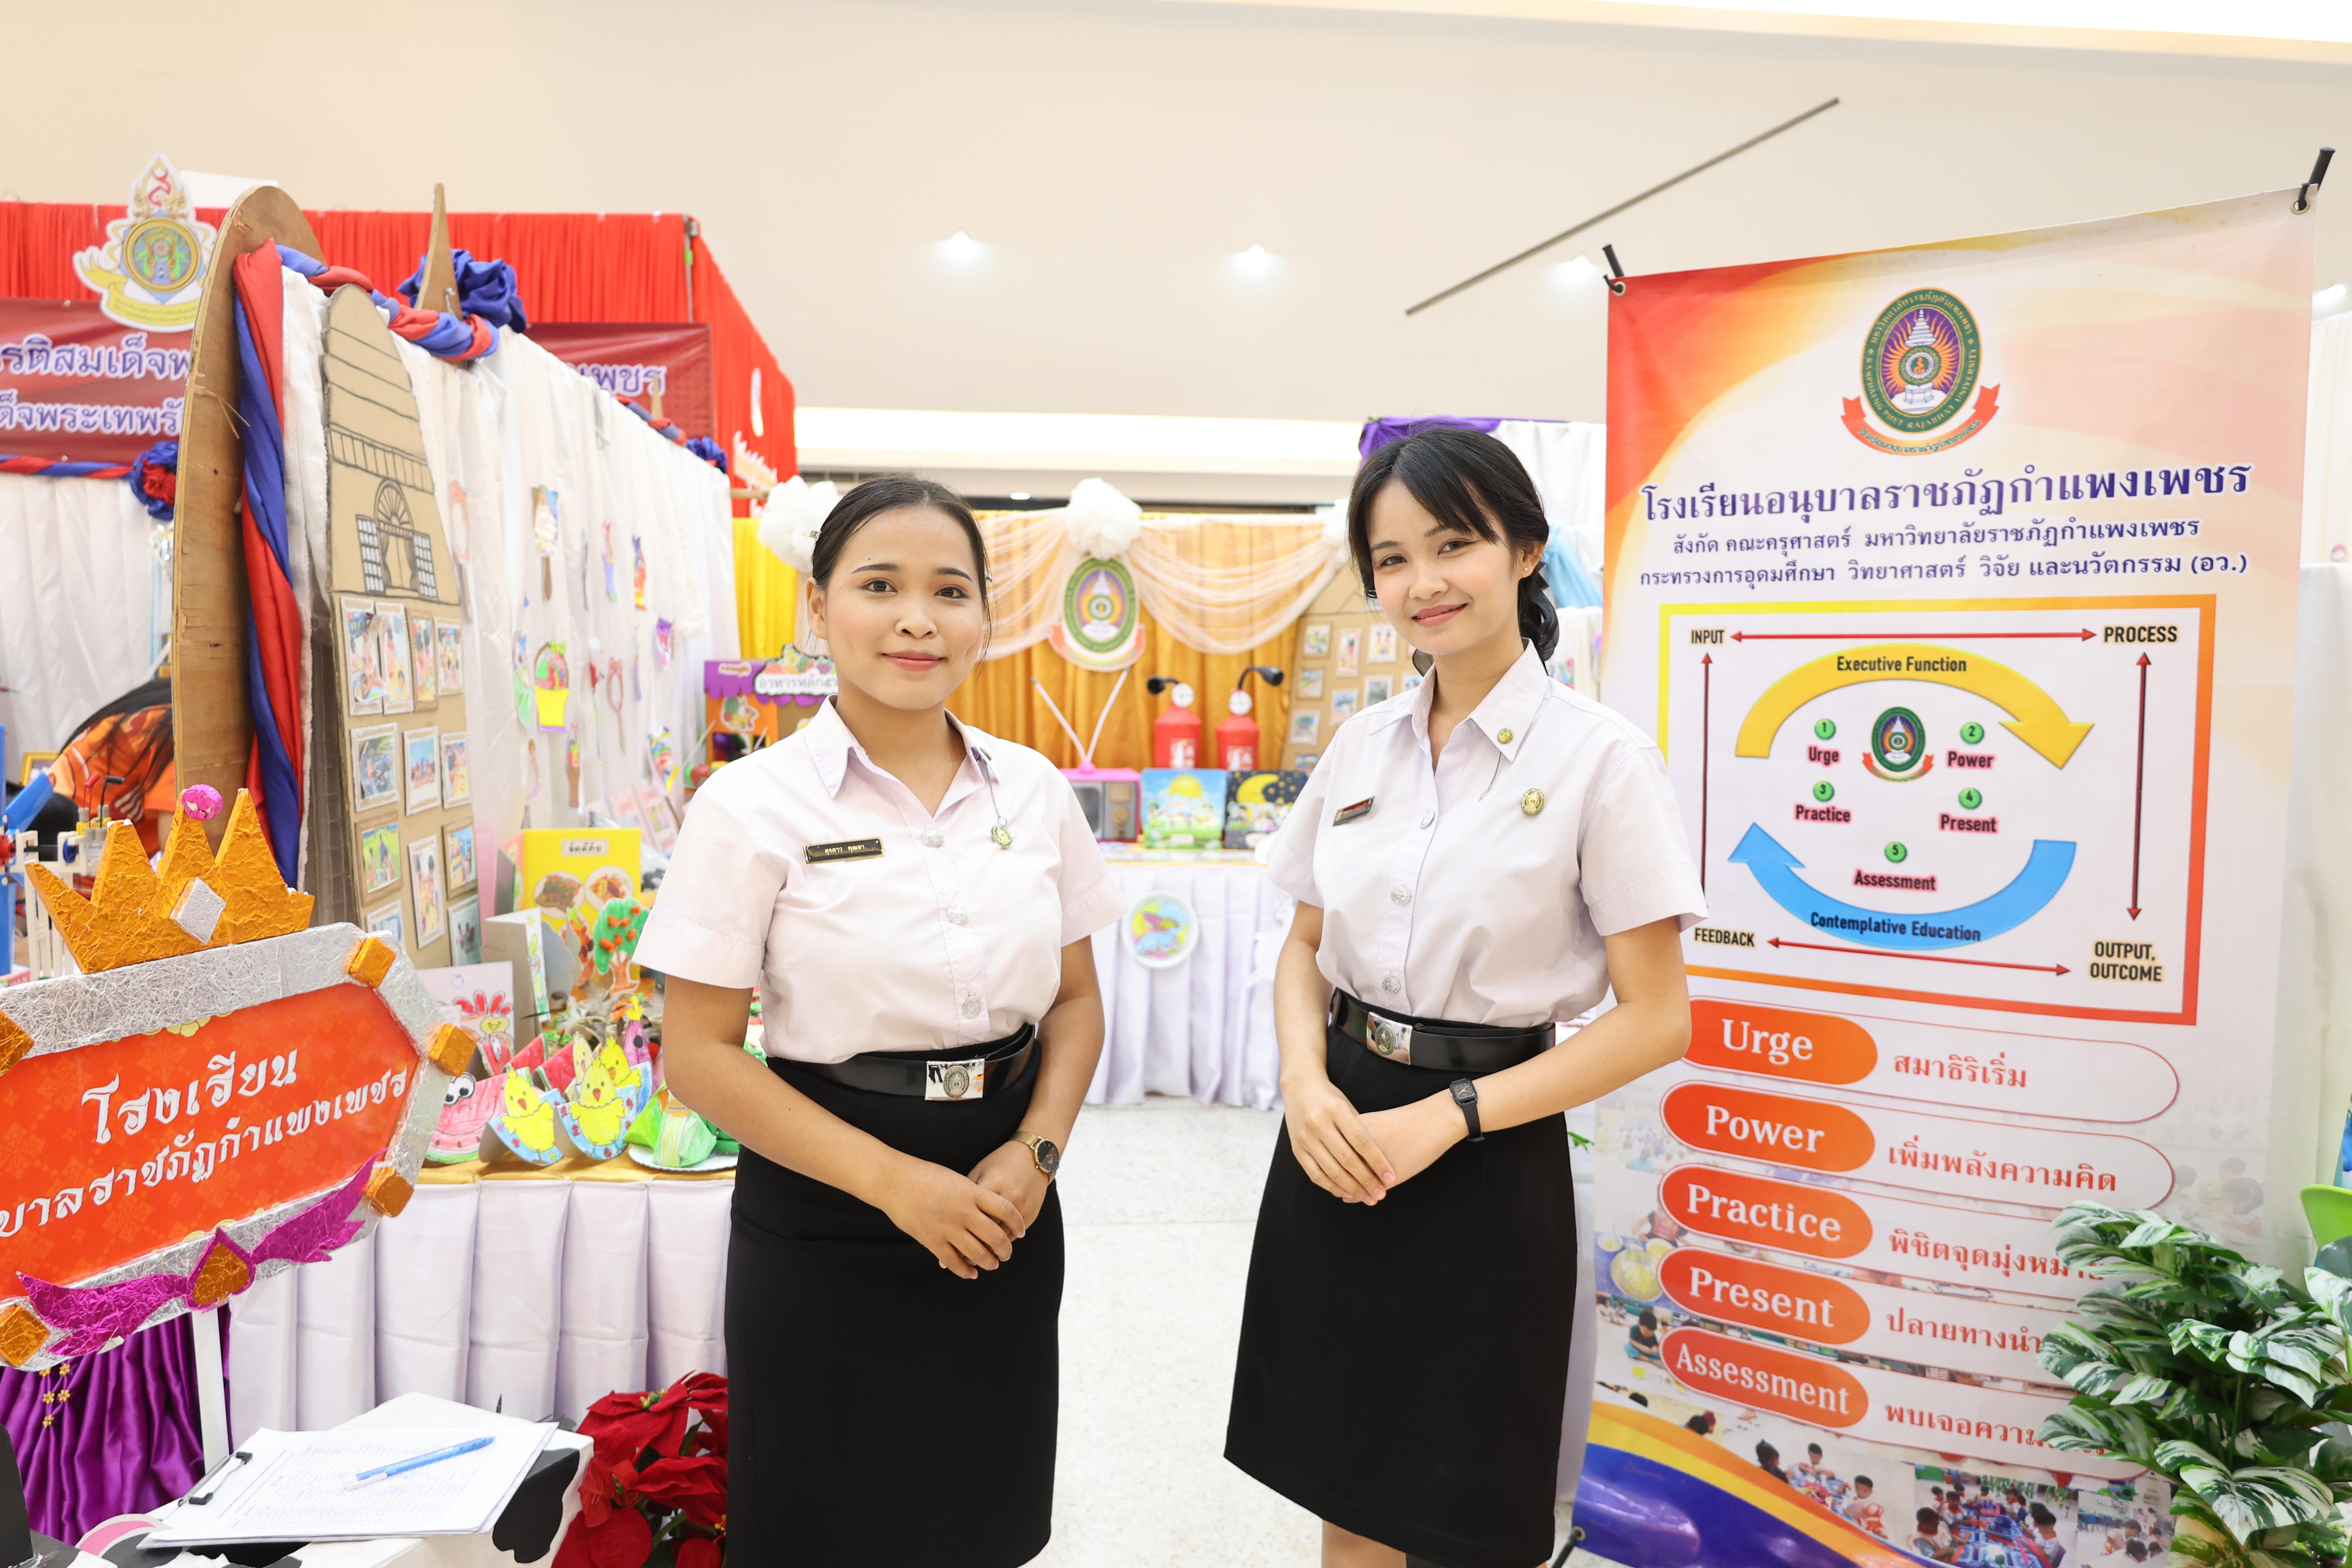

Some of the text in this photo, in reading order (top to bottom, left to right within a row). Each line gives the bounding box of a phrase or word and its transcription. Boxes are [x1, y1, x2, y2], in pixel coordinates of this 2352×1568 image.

[1882, 410, 1904, 426] PHET
[1906, 404, 1955, 429] RAJABHAT
[1641, 464, 2252, 523] โรงเรียนอนุบาลราชภัฏกำแพงเพชร
[1673, 517, 2200, 557] สังกัด คณะครุศาสตร์ มหาวิทยาลัยราชภัฏกำแพงเพชร
[1641, 551, 2247, 590] กระทรวงการอุดมศึกษา วิทยาศาสตร์ วิจัย และนวัตกรรม (อว.)
[1691, 630, 1724, 644] INPUT
[2104, 625, 2178, 643] PROCESS
[1837, 656, 1967, 672] Executive Function
[1822, 723, 1827, 733] 1
[1968, 726, 1976, 737] 2
[1809, 747, 1839, 765] Urge
[1947, 751, 1993, 768] Power
[1820, 784, 1827, 795] 3
[1965, 791, 1973, 802] 4
[1795, 805, 1851, 823] Practice
[1940, 814, 1997, 833] Present
[1892, 844, 1899, 856] 5
[1855, 871, 1936, 891] Assessment
[1694, 927, 1755, 947] FEEDBACK
[1811, 912, 1981, 942] Contemplative Education
[2094, 941, 2156, 962] OUTPUT,
[2089, 962, 2162, 982] OUTCOME
[1721, 1019, 1814, 1065] Urge
[1894, 1052, 2027, 1088] สมาธิริเริ่ม
[81, 1049, 298, 1145] โรงเรียน
[1705, 1104, 1825, 1153] Power
[0, 1067, 408, 1238] บาลราชภัฏกำแพงเพชร
[1889, 1135, 2116, 1191] เพิ่มพลังความคิด
[1686, 1183, 1842, 1242] Practice
[1689, 1267, 1834, 1328] Present
[1676, 1343, 1849, 1416] Assessment
